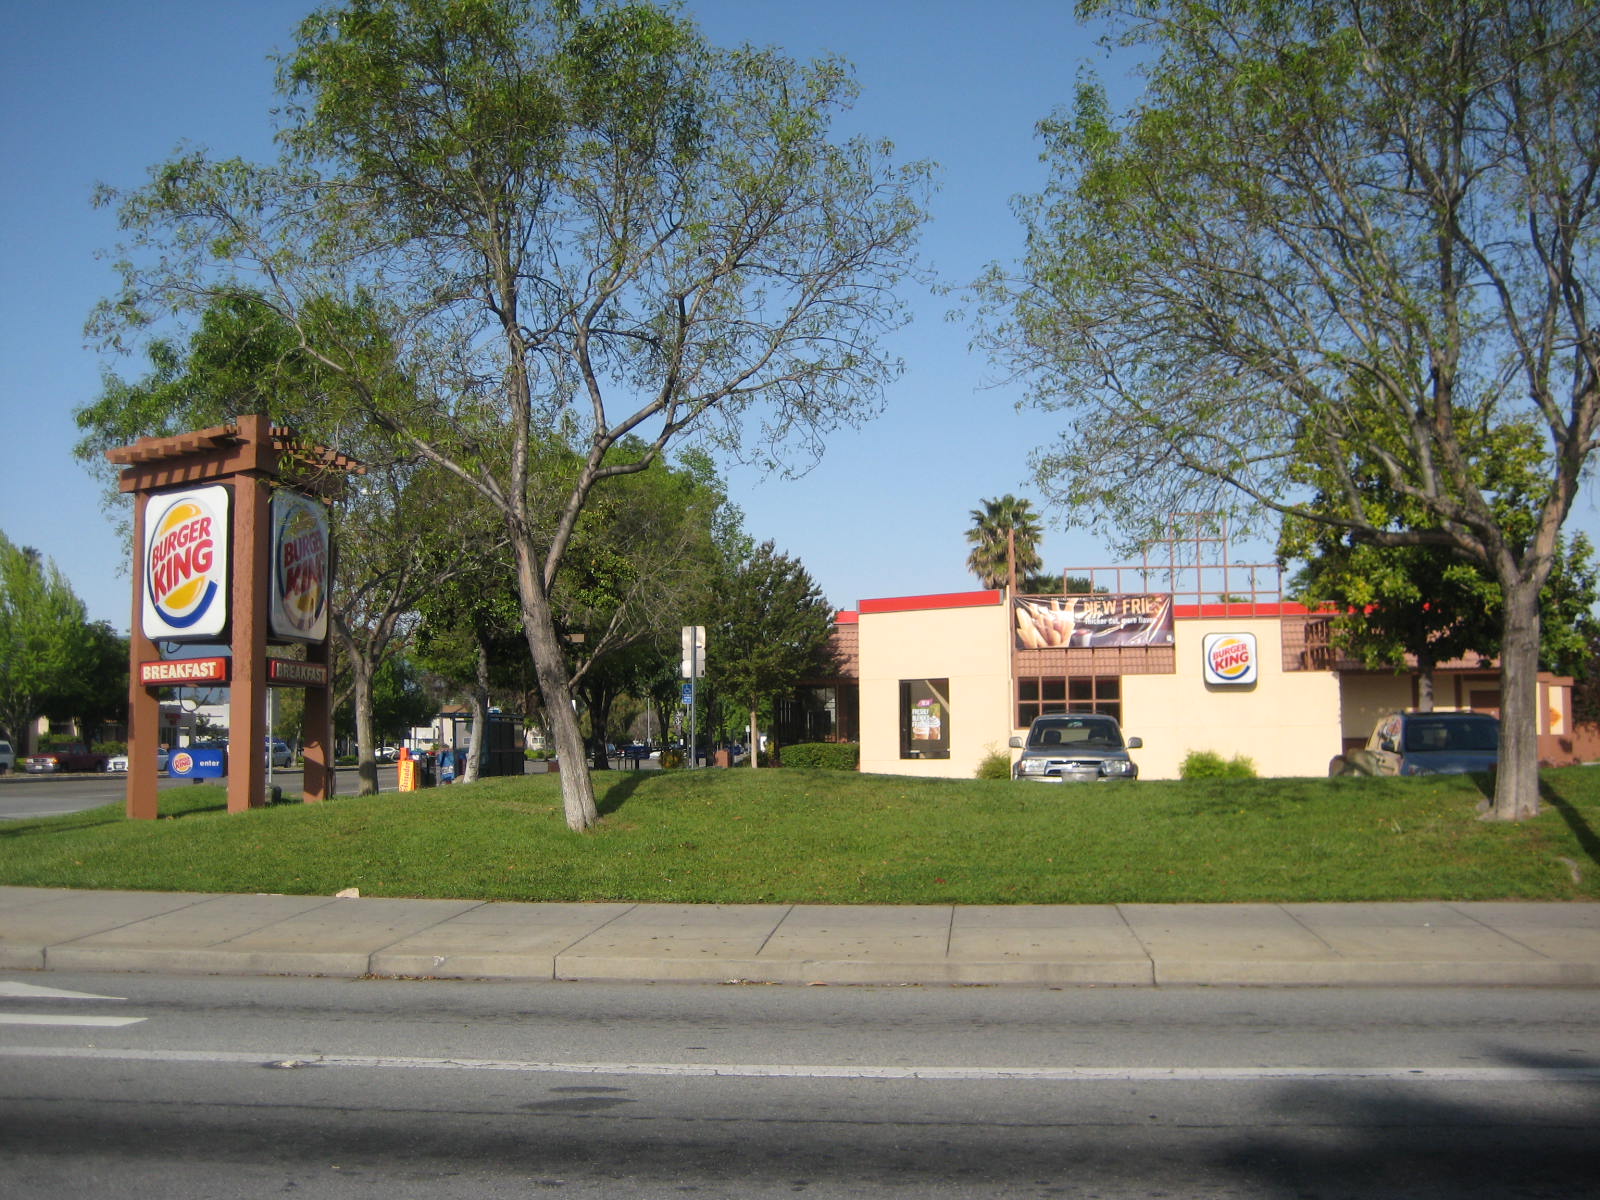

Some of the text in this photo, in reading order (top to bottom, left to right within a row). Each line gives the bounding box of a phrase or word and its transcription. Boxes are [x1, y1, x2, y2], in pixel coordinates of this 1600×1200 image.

[152, 516, 212, 571] BURGER
[154, 538, 213, 604] KING
[1084, 600, 1116, 615] NEW
[1213, 643, 1247, 661] BURGER
[1215, 651, 1249, 672] KING
[143, 661, 217, 680] BREAKFAST
[276, 662, 325, 682] BREAKFAST
